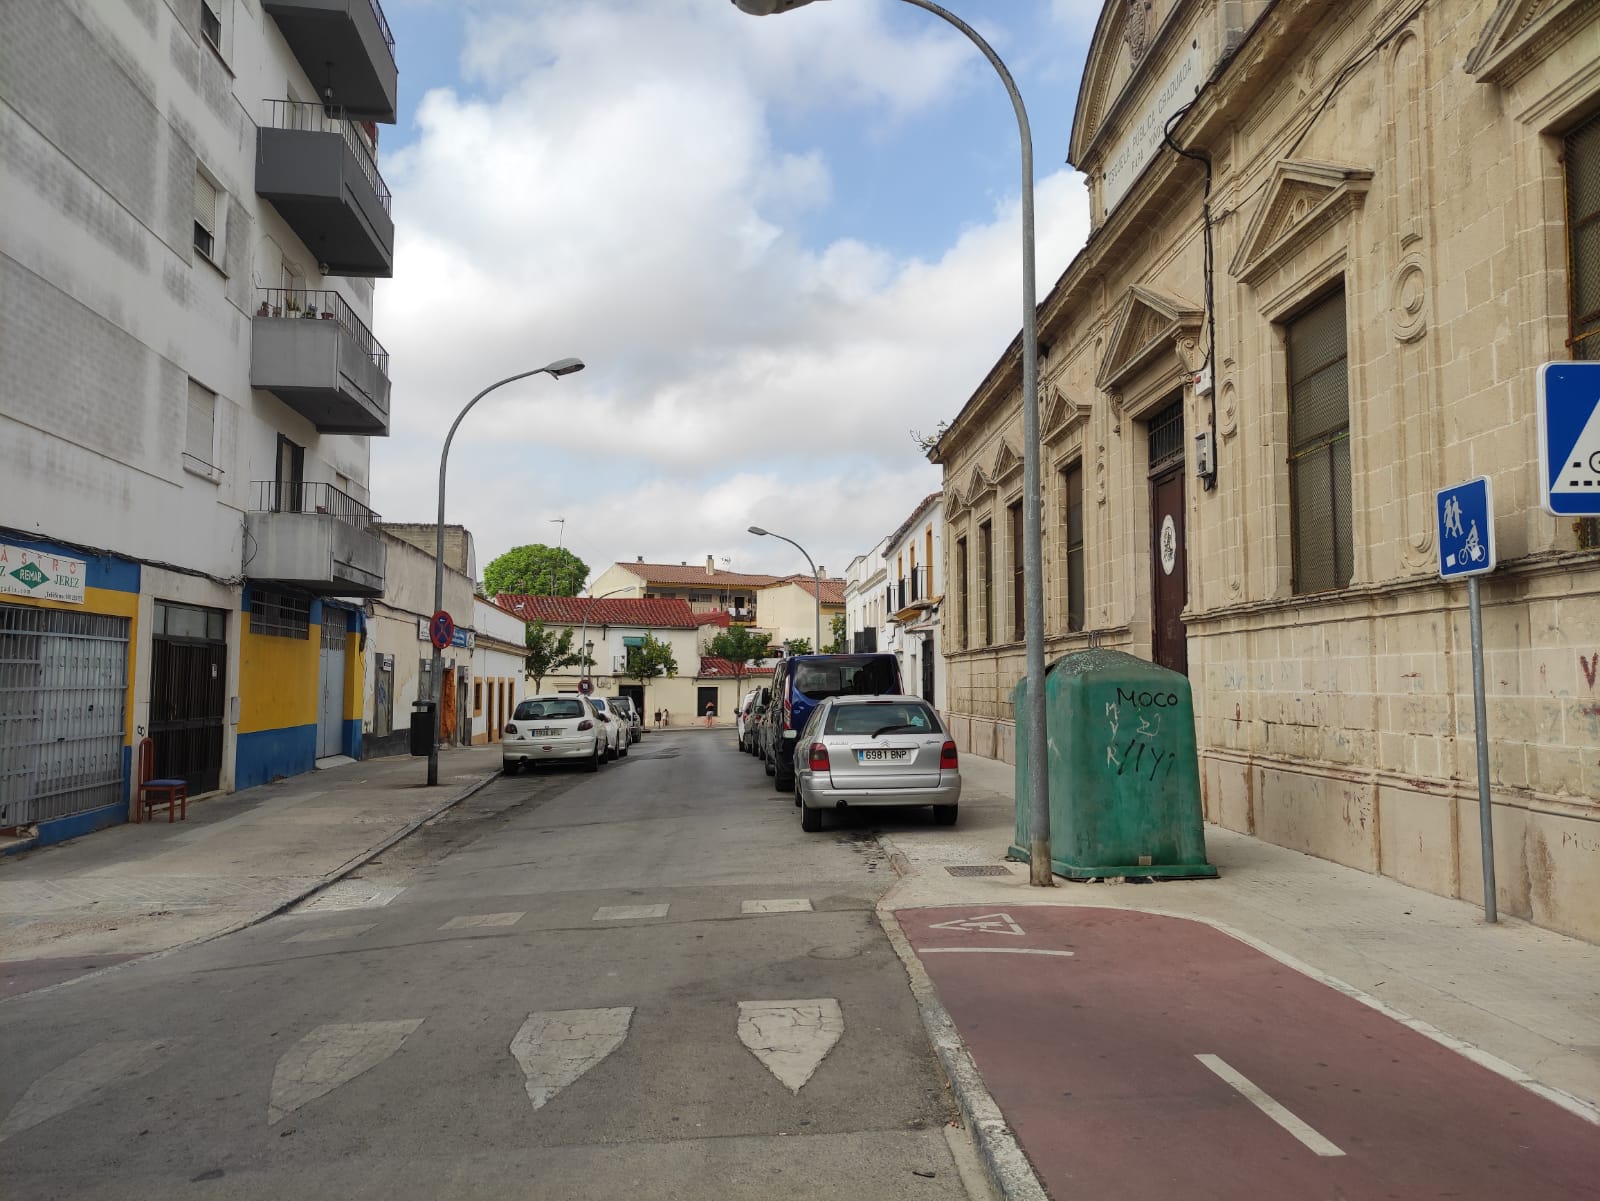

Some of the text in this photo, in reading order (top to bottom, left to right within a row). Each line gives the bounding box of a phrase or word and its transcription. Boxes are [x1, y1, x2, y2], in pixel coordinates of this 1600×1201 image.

[1108, 147, 1130, 187] ESCUELA
[20, 569, 42, 583] REMAR
[54, 575, 80, 588] JEREZ
[1116, 687, 1178, 708] MOCO
[865, 750, 907, 759] 6981 BNP
